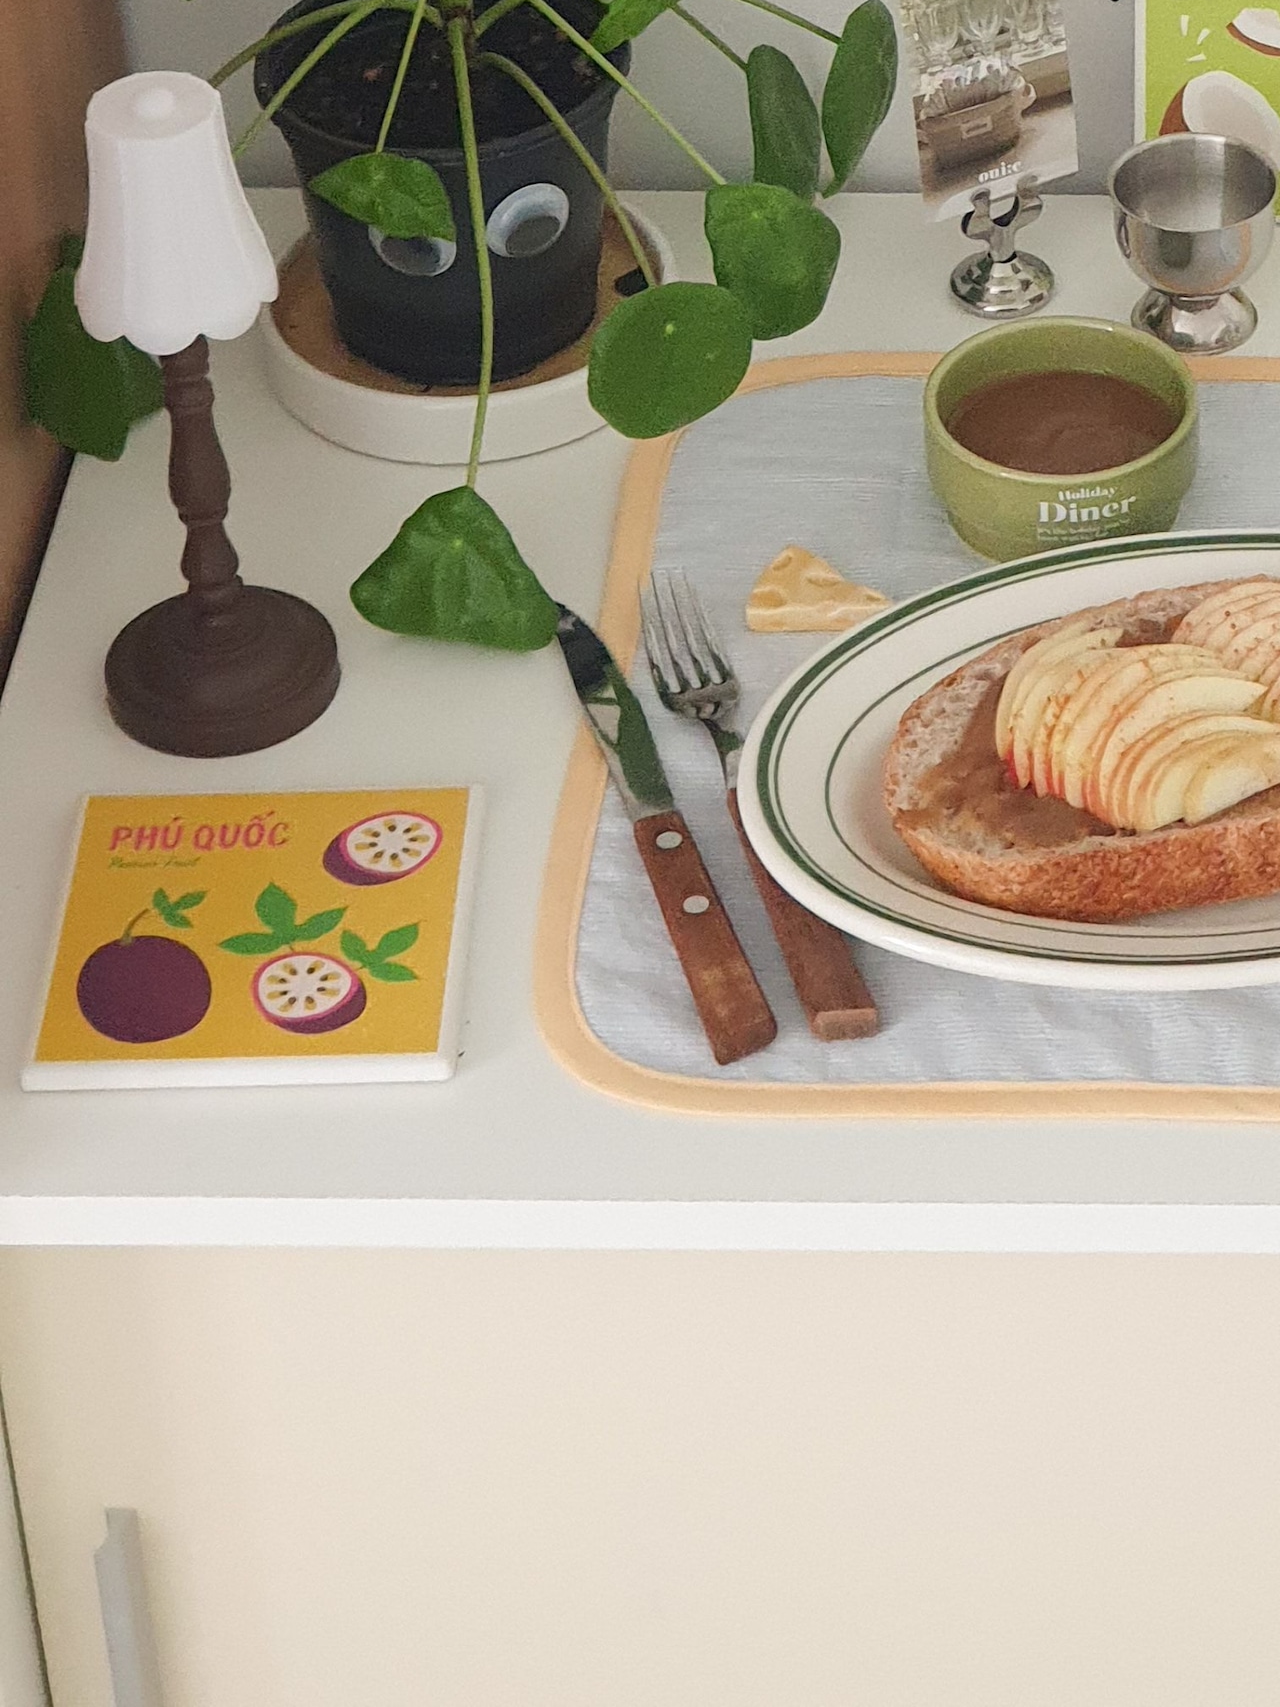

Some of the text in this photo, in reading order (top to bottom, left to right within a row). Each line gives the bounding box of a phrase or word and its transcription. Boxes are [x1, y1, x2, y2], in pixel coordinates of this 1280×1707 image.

[1058, 486, 1119, 502] Holiday
[1039, 495, 1137, 524] Diner
[109, 809, 290, 853] PHÚ QUỐC
